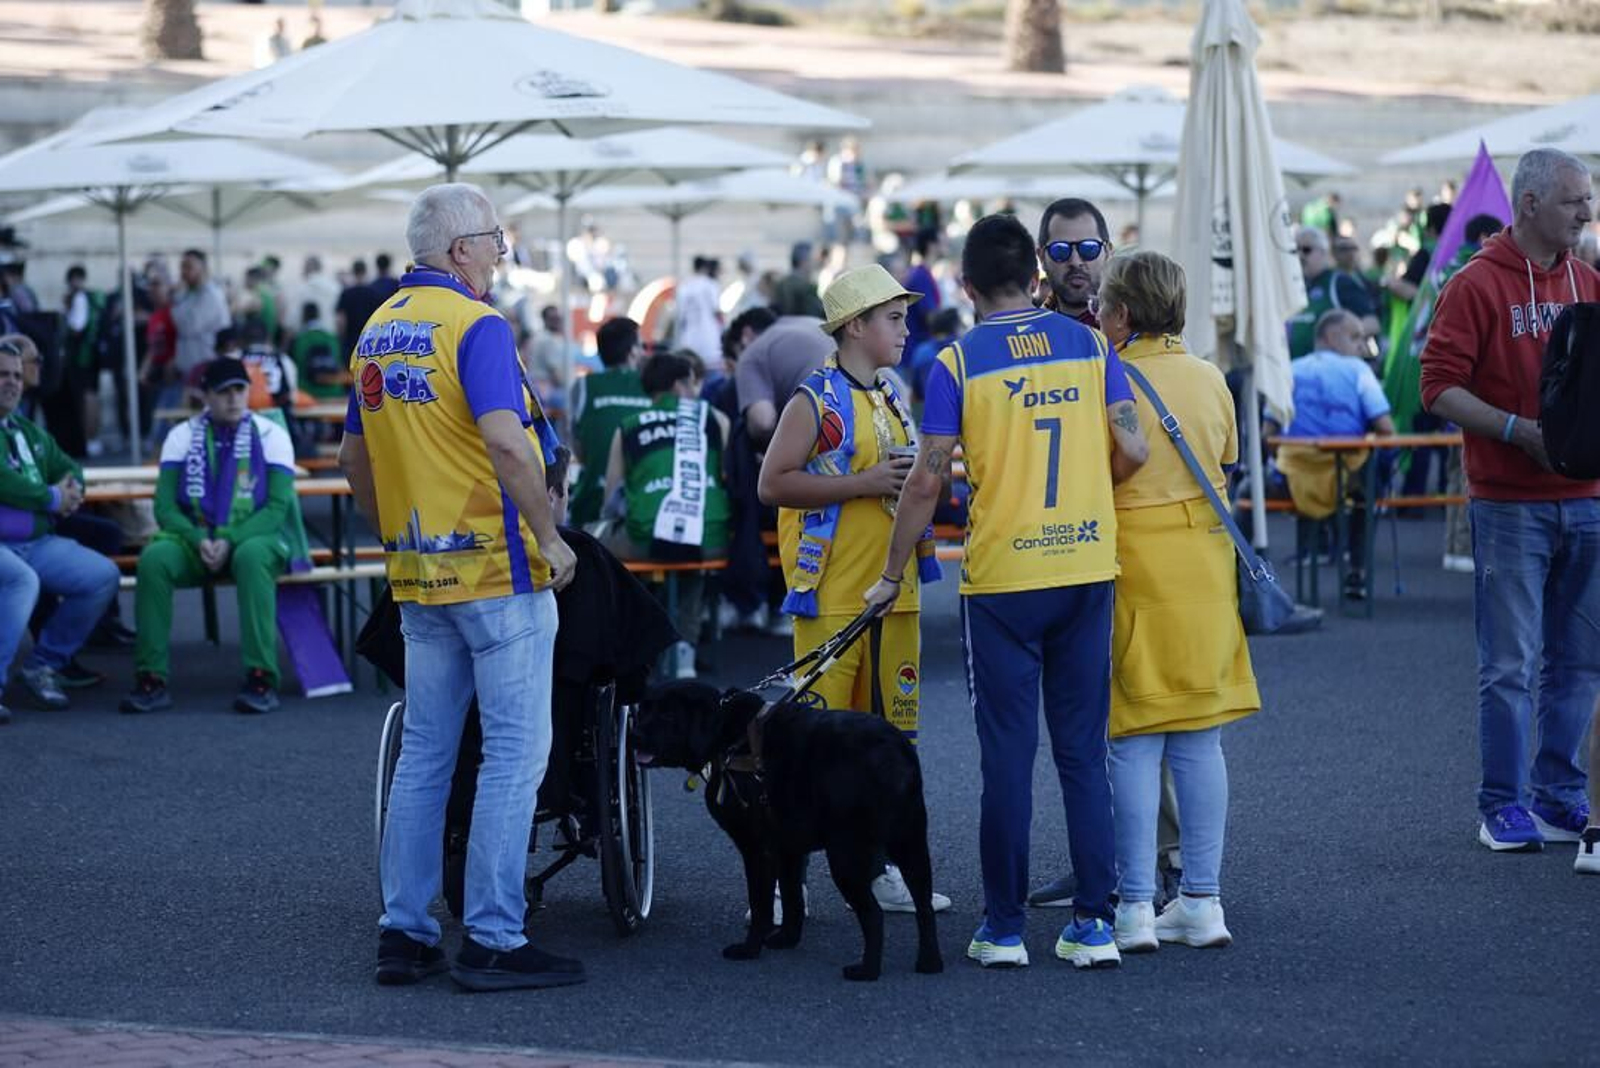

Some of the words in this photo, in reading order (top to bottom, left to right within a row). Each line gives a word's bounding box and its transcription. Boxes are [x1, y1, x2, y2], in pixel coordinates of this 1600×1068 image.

[1006, 331, 1053, 359] DANI
[1034, 417, 1062, 509] 7
[1041, 523, 1076, 536] Islas
[1012, 532, 1077, 551] Canarias
[893, 695, 918, 709] Poem
